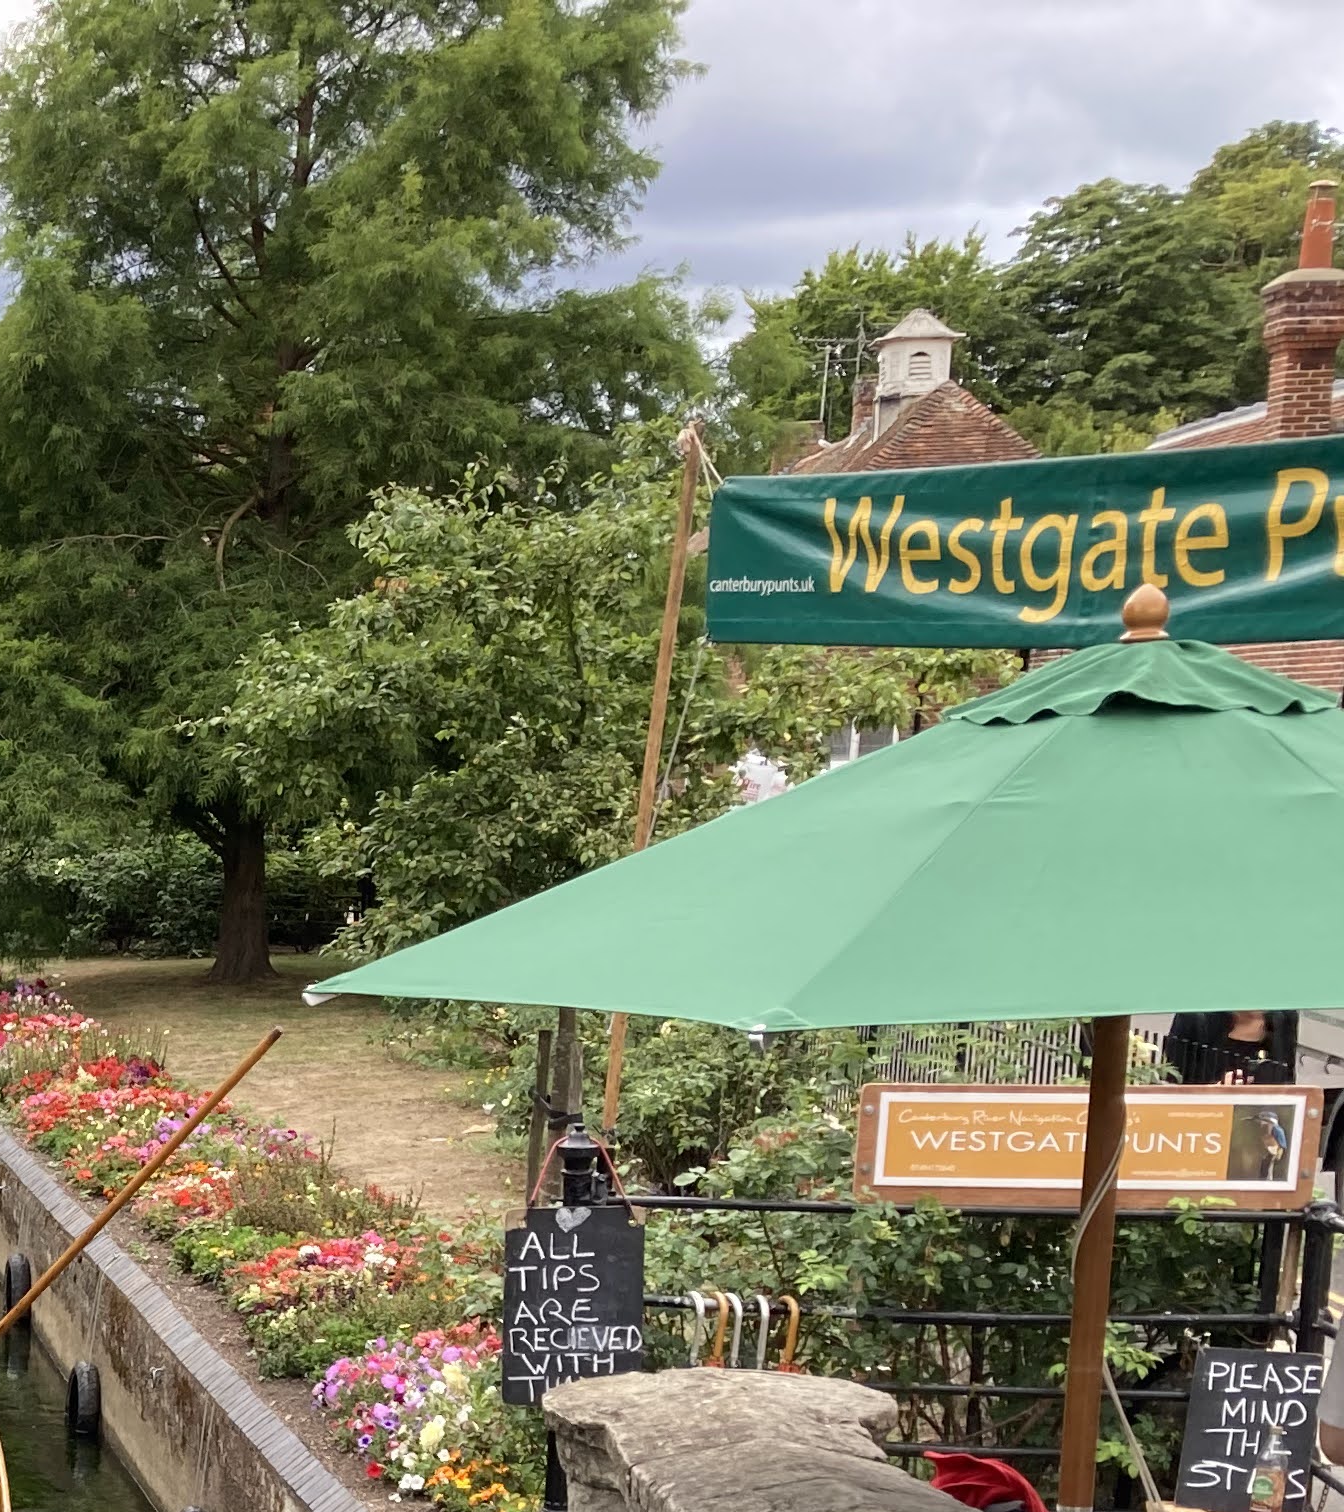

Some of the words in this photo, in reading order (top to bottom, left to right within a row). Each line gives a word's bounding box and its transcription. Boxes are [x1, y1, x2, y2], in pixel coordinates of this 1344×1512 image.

[823, 486, 1230, 624] Westgate
[709, 575, 816, 596] canterburypunts.uk
[1124, 1132, 1222, 1154] UNTS
[519, 1231, 595, 1260] ALL
[508, 1263, 601, 1291] TIPS
[514, 1298, 599, 1325] ARE
[509, 1324, 643, 1355] RECIEVED
[521, 1352, 615, 1374] WITH
[1208, 1361, 1323, 1394] PLEASE
[1221, 1397, 1308, 1427] MIND
[1204, 1428, 1293, 1457] THE
[1185, 1459, 1307, 1499] STS
